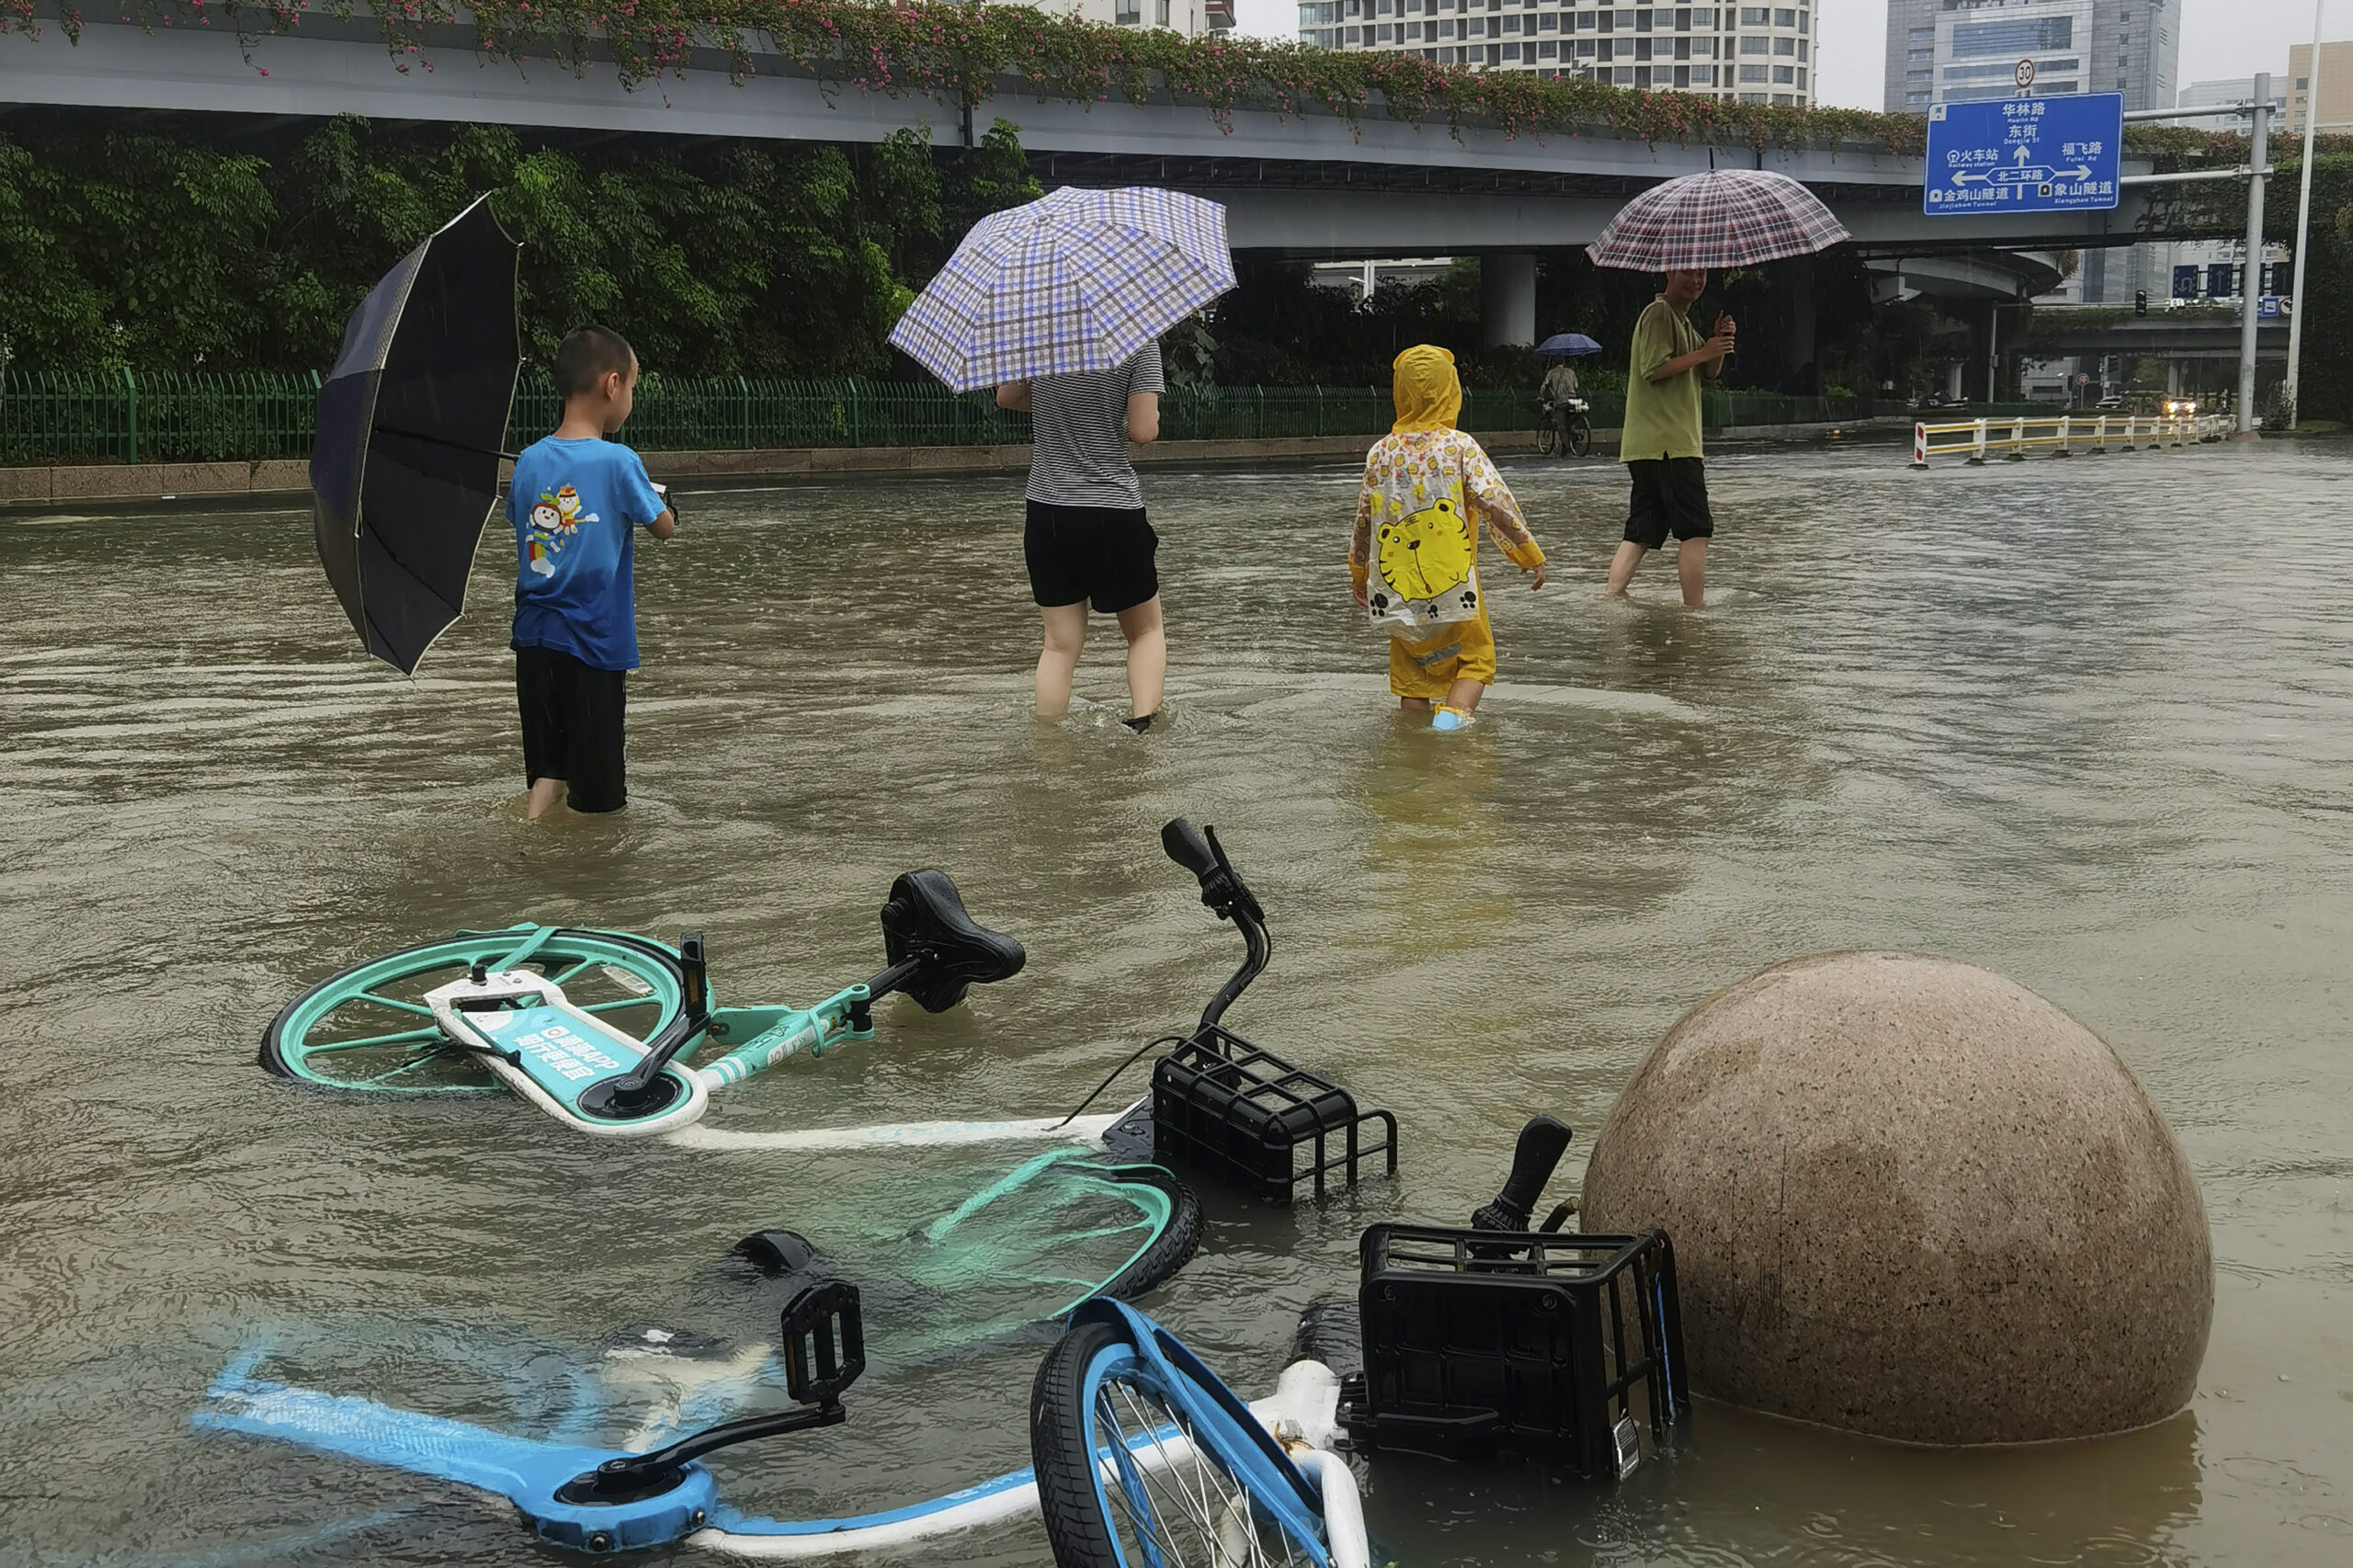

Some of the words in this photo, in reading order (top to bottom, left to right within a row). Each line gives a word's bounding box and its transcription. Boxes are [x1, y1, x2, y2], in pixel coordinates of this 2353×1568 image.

[2019, 66, 2030, 81] 30
[2002, 102, 2046, 117] 华林路
[2008, 124, 2038, 138] 东街
[1961, 148, 1999, 162] 火车站
[2062, 142, 2102, 156] 福飞路
[1997, 169, 2043, 182] 北二环路
[1944, 187, 2009, 202] 金鸡山隧道
[2054, 181, 2113, 196] 象山隧道
